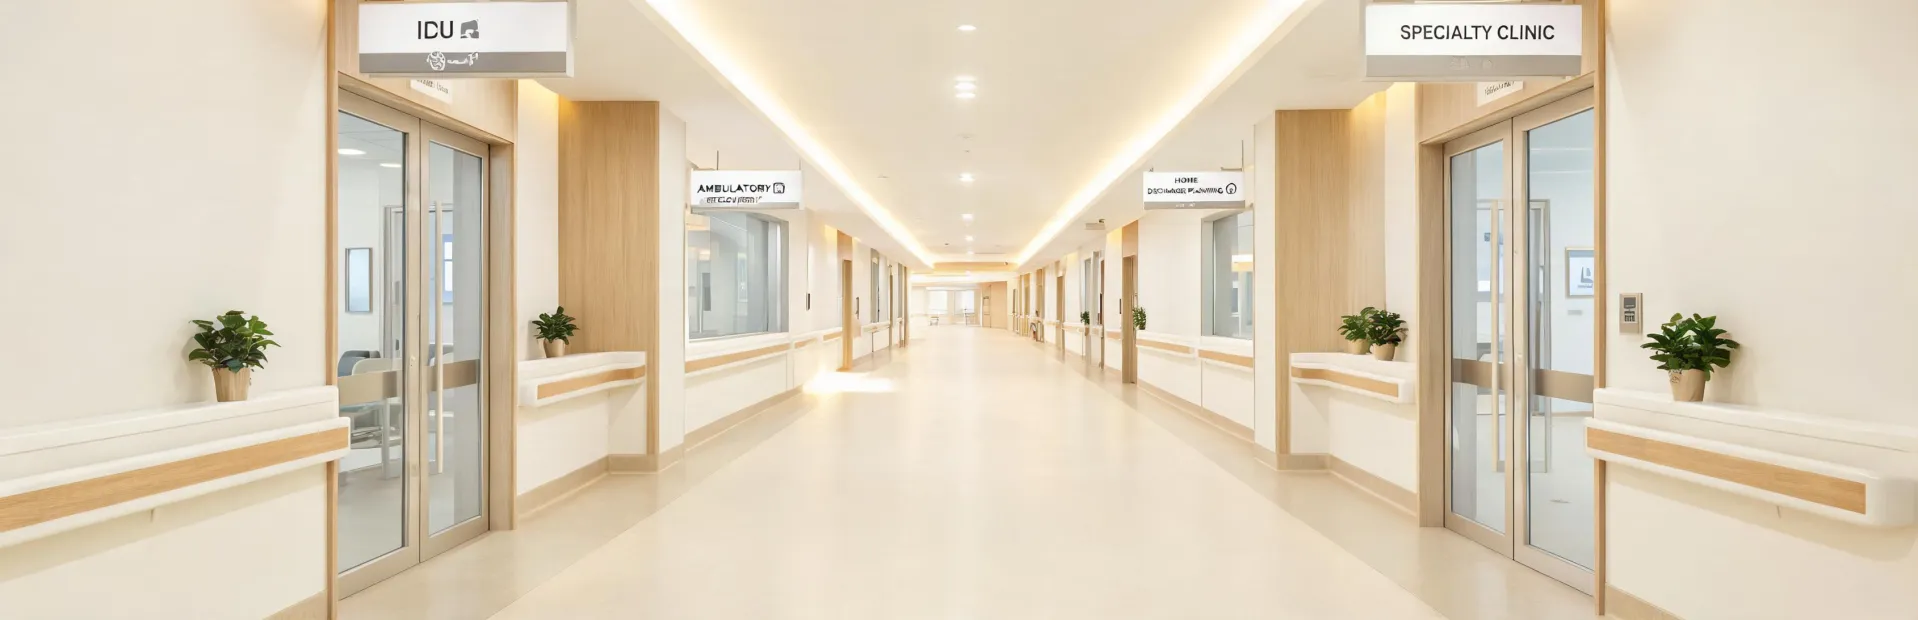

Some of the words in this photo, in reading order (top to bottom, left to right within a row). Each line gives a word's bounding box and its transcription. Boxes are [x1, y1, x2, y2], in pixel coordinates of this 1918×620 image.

[1400, 24, 1492, 40] SPECIALTY
[1497, 24, 1555, 40] CLINIC
[697, 184, 771, 193] AMBULATORY
